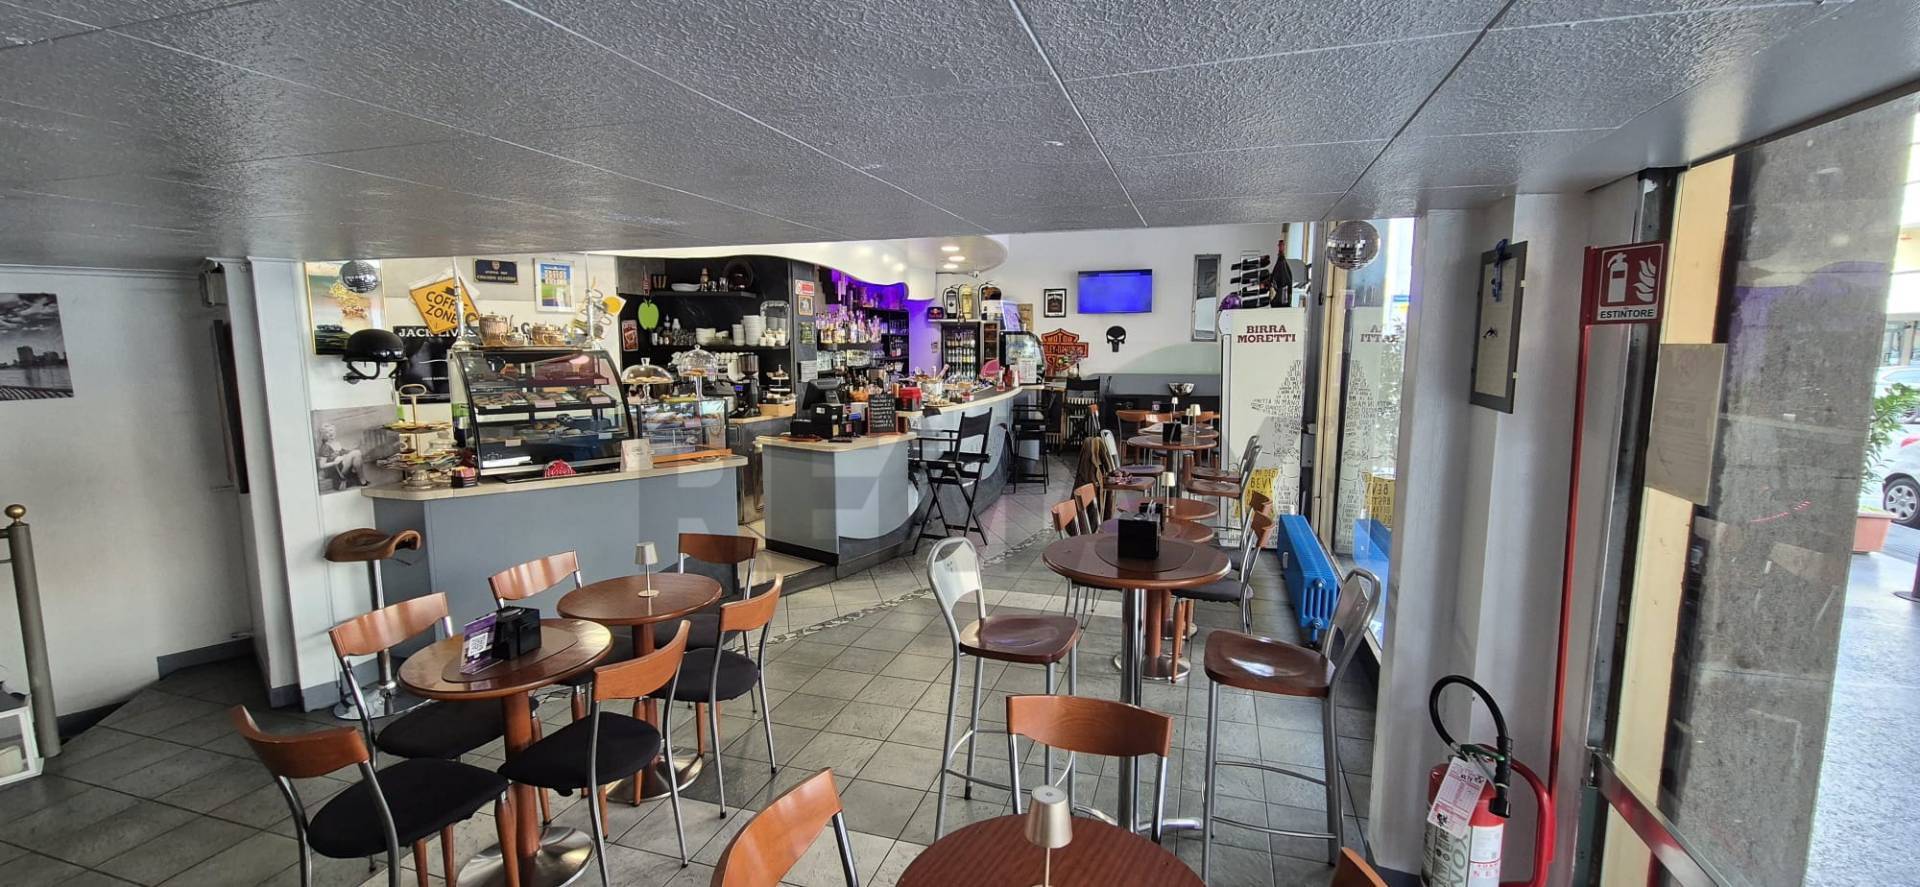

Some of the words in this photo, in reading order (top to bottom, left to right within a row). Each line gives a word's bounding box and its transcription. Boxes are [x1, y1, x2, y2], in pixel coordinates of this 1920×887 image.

[426, 291, 469, 311] COFF
[425, 304, 457, 324] ZONE
[1600, 309, 1655, 319] ESTINTORE
[1246, 325, 1287, 333] BIRRA
[1237, 334, 1296, 343] MORETTI
